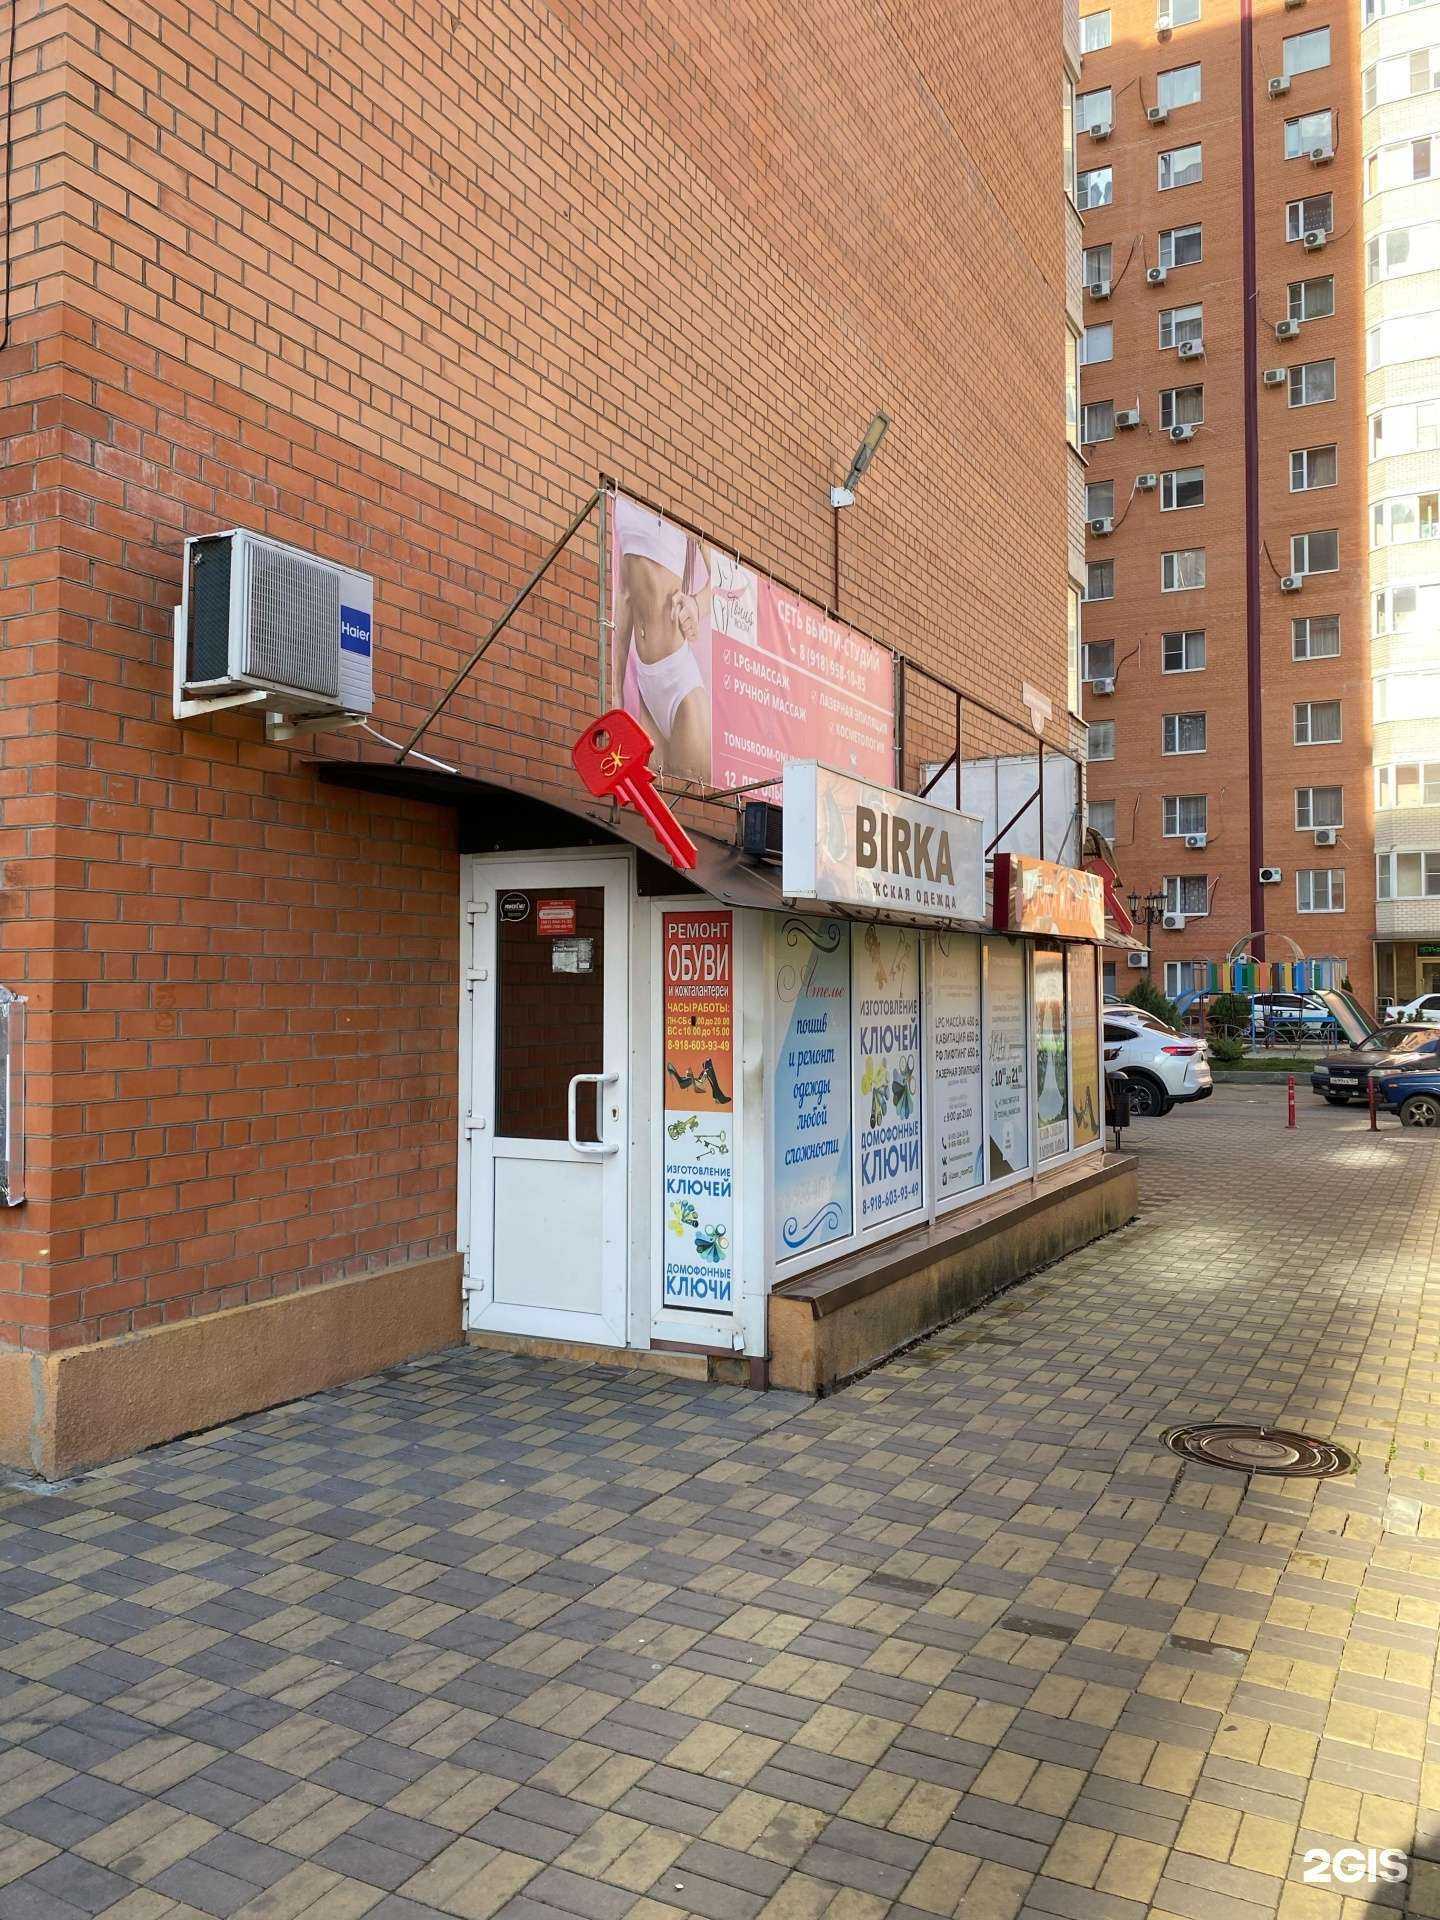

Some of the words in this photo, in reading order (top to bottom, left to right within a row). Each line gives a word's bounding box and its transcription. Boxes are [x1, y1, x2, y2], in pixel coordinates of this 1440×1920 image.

[778, 600, 803, 630] СЕТЬ
[342, 621, 370, 642] Haier
[734, 652, 791, 690] LPG-МАССАЖ
[734, 678, 770, 706] РУЧНОЙ
[772, 695, 807, 722] МАССАЖ
[725, 771, 736, 788] 12
[856, 805, 955, 886] BIRKA
[916, 890, 957, 909] ОДЕЖДА
[669, 922, 729, 938] РЕМОНТ
[669, 944, 729, 981] ОБУВИ
[668, 985, 674, 996] и
[675, 985, 729, 999] кожгалантереи
[668, 1003, 691, 1012] ЧАСЫ
[692, 1003, 730, 1012] РАБОТЫ:
[860, 1000, 917, 1016] ИЗГОТОВЛЕНИЕ
[668, 1026, 678, 1036] ВС
[702, 1028, 711, 1038] до
[797, 1012, 828, 1034] пошив
[667, 1039, 730, 1051] 8-918-603-93-49
[860, 1016, 918, 1056] КЛЮЧЕЙ
[788, 1051, 795, 1067] и
[796, 1048, 835, 1077] ремонт
[995, 1069, 1002, 1087] 10
[793, 1079, 831, 1109] одежды
[796, 1105, 827, 1130] любой
[861, 1120, 919, 1151] ДОМОФОННЫЕ
[785, 1138, 839, 1166] сложности
[861, 1139, 919, 1187] КЛЮЧИ
[666, 1164, 731, 1177] ИЗГОТОВЛЕНИЕ
[666, 1177, 731, 1198] КЛЮЧЕЙ
[862, 1181, 919, 1215] 8-918-603-93-49
[666, 1263, 731, 1279] ДОМОФОННЫЕ
[666, 1276, 731, 1301] КЛЮЧИ
